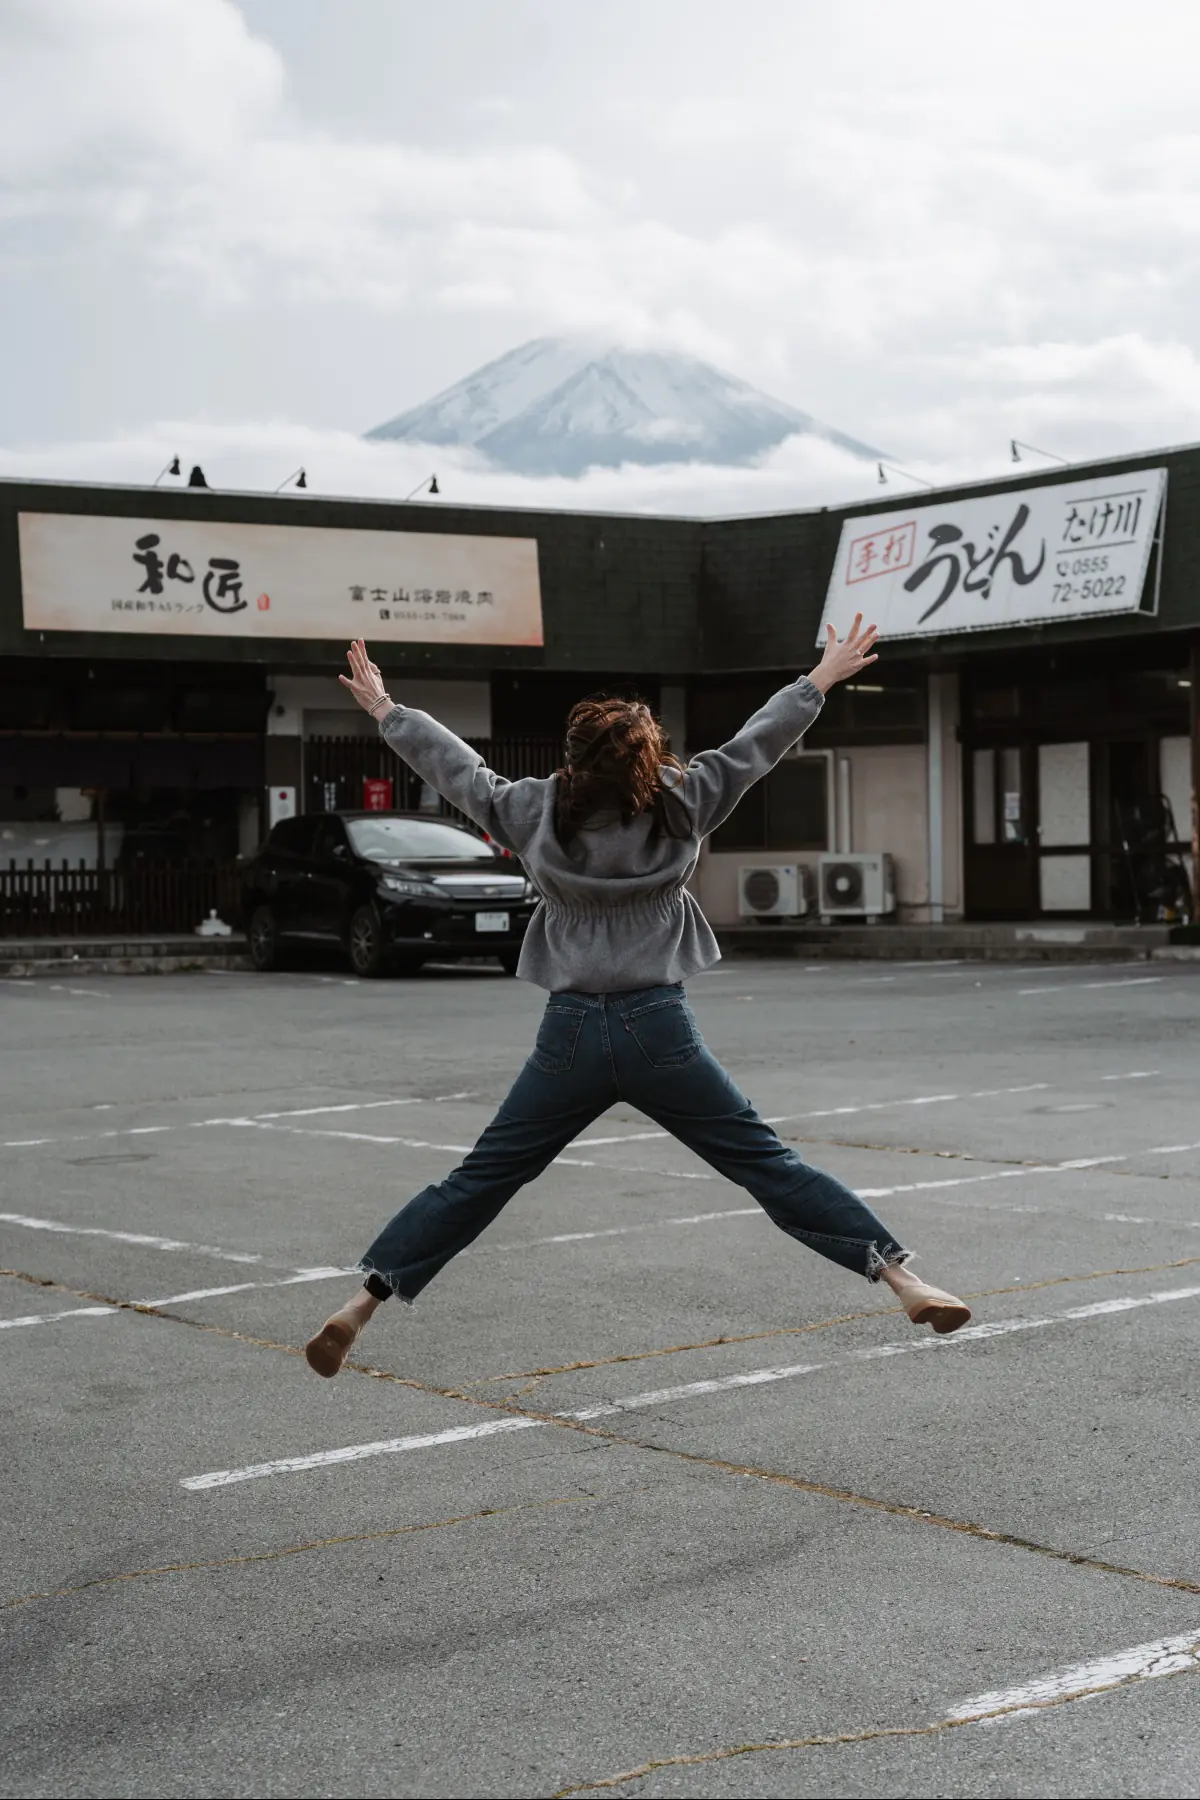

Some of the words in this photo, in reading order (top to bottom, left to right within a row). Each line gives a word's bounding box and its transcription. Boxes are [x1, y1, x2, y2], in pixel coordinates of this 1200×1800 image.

[1062, 496, 1142, 543] たけ川
[132, 533, 248, 614] 和匠
[854, 532, 905, 574] 手打
[903, 503, 1046, 625] うどん
[1072, 555, 1109, 576] 0555
[1052, 575, 1127, 603] 72-5022
